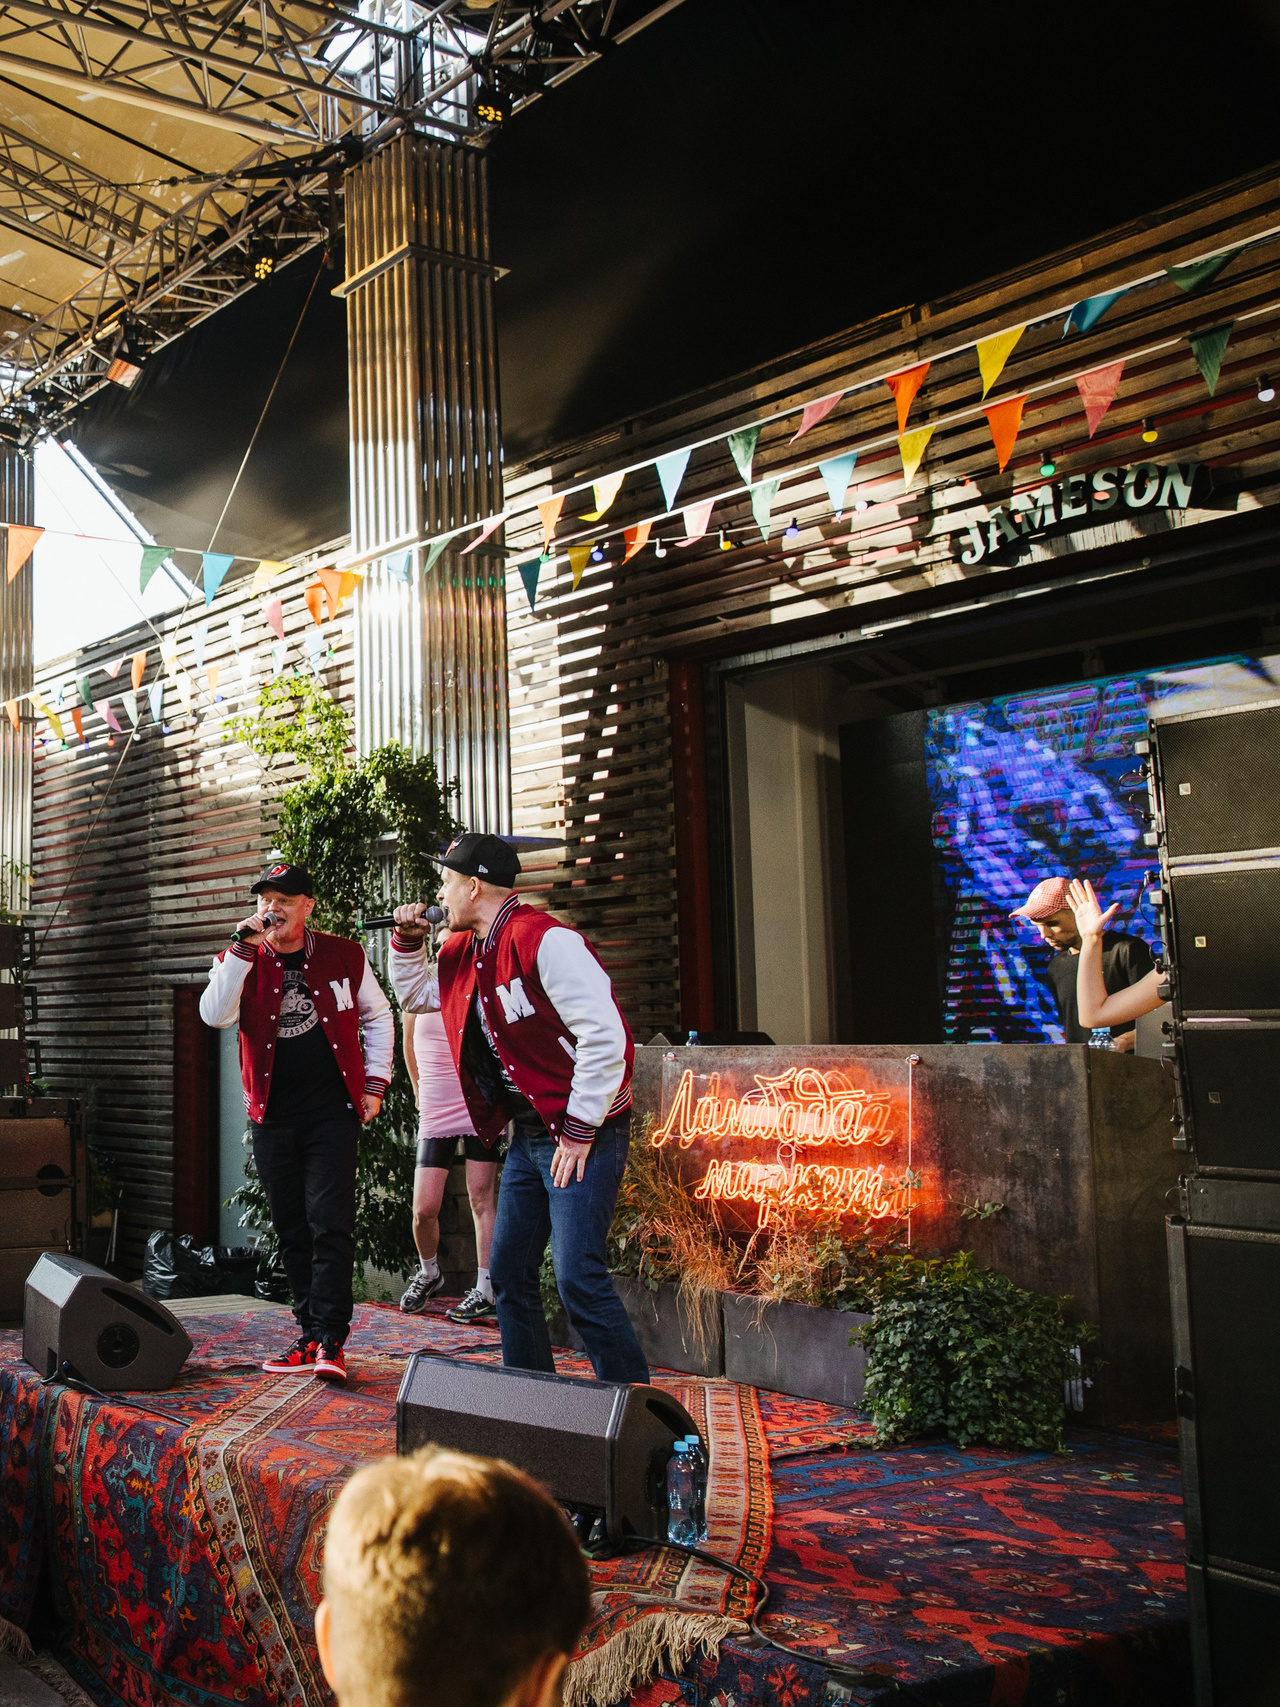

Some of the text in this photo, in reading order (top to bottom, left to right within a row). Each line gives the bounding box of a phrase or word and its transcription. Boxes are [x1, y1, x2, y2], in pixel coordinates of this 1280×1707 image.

[961, 462, 1200, 566] JAMESON
[329, 977, 354, 1012] M
[495, 977, 536, 1025] M
[284, 1018, 315, 1036] FASTER
[651, 1067, 870, 1148] Ламбада
